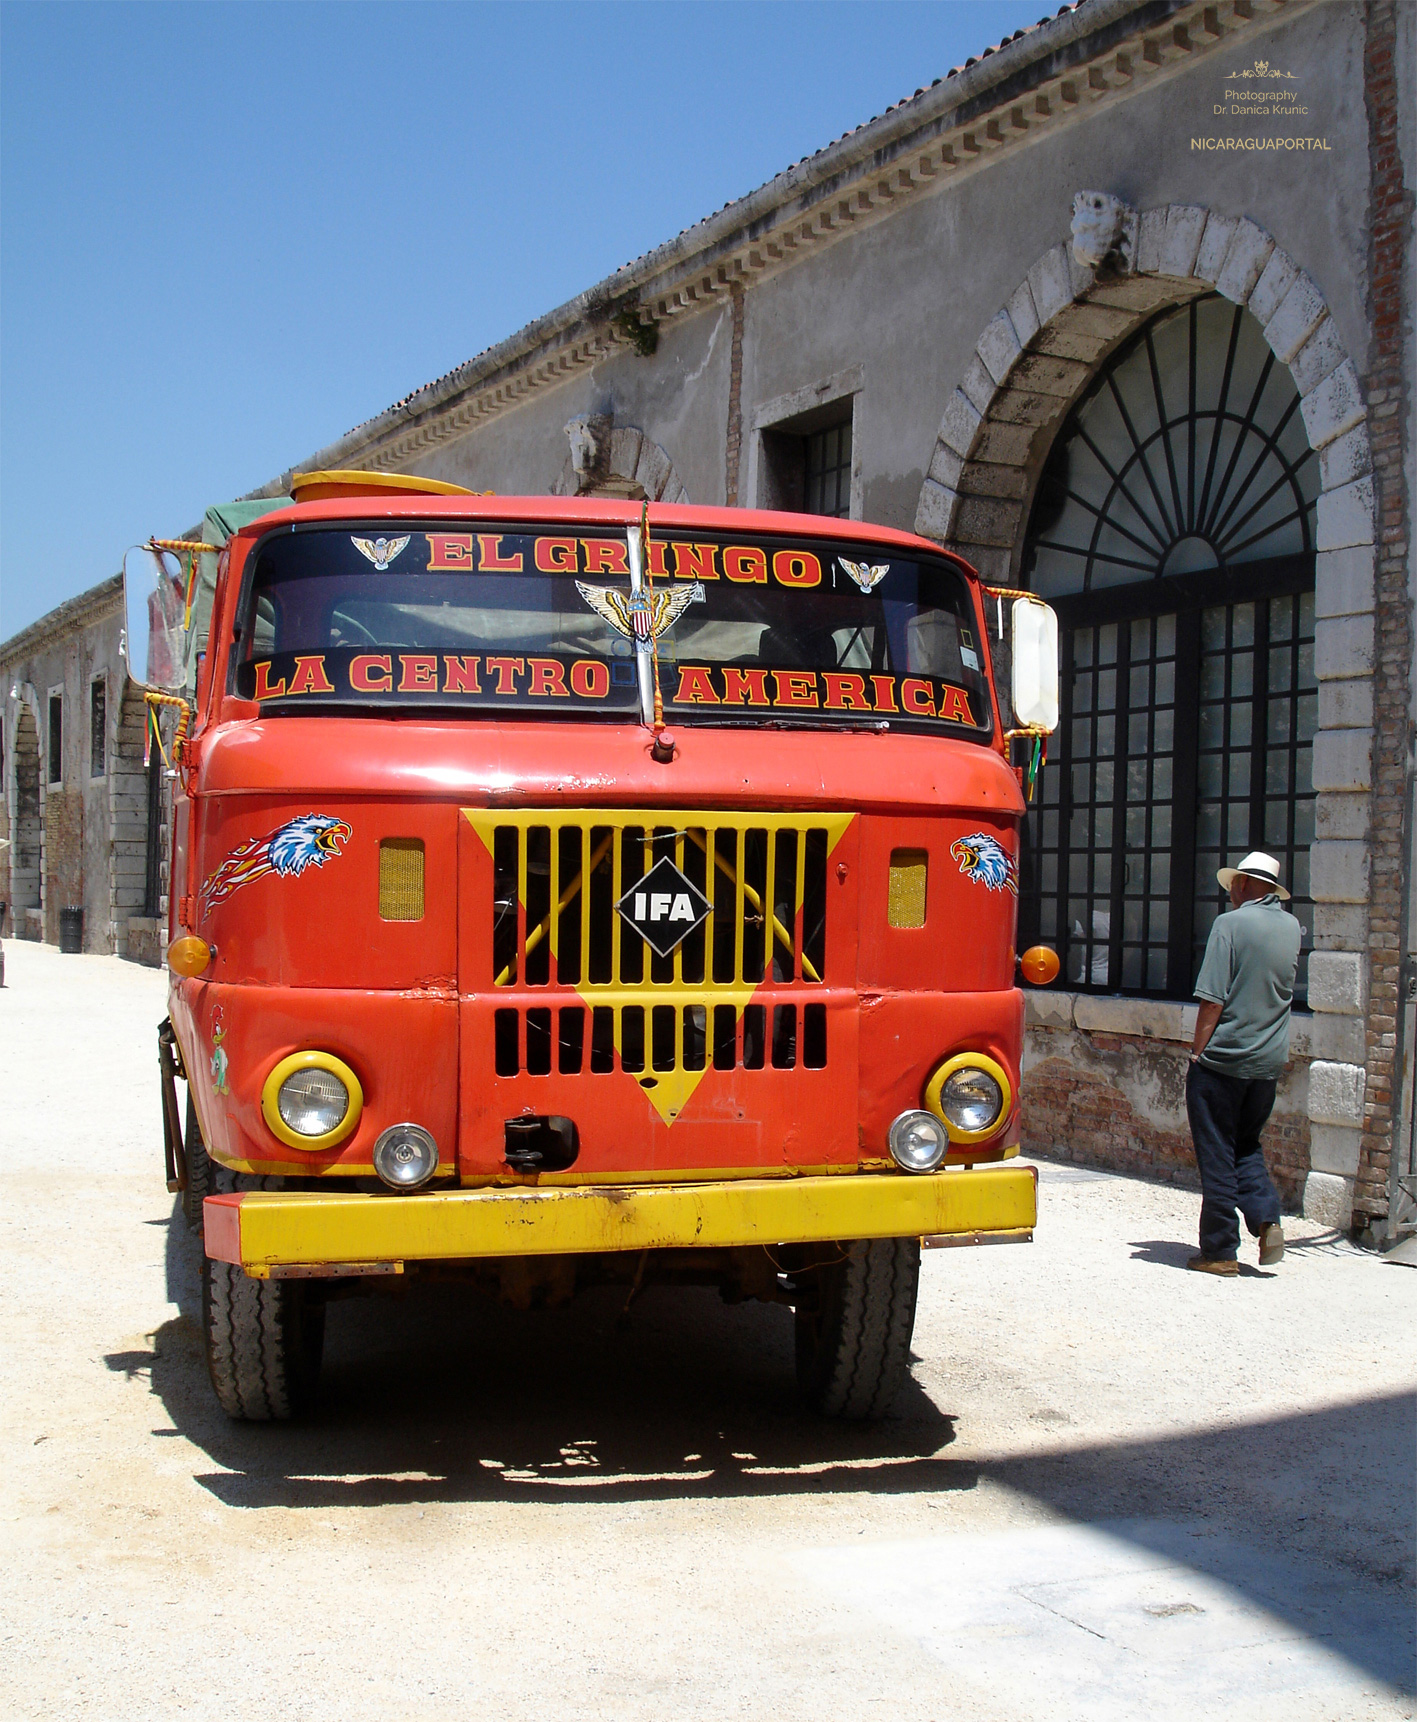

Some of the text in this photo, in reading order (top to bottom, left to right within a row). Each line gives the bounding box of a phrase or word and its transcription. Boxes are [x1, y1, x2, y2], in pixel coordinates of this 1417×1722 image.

[425, 533, 823, 588] EL GRINGO
[254, 654, 977, 727] LA CENTRO AMERICA
[635, 892, 695, 922] IFA
